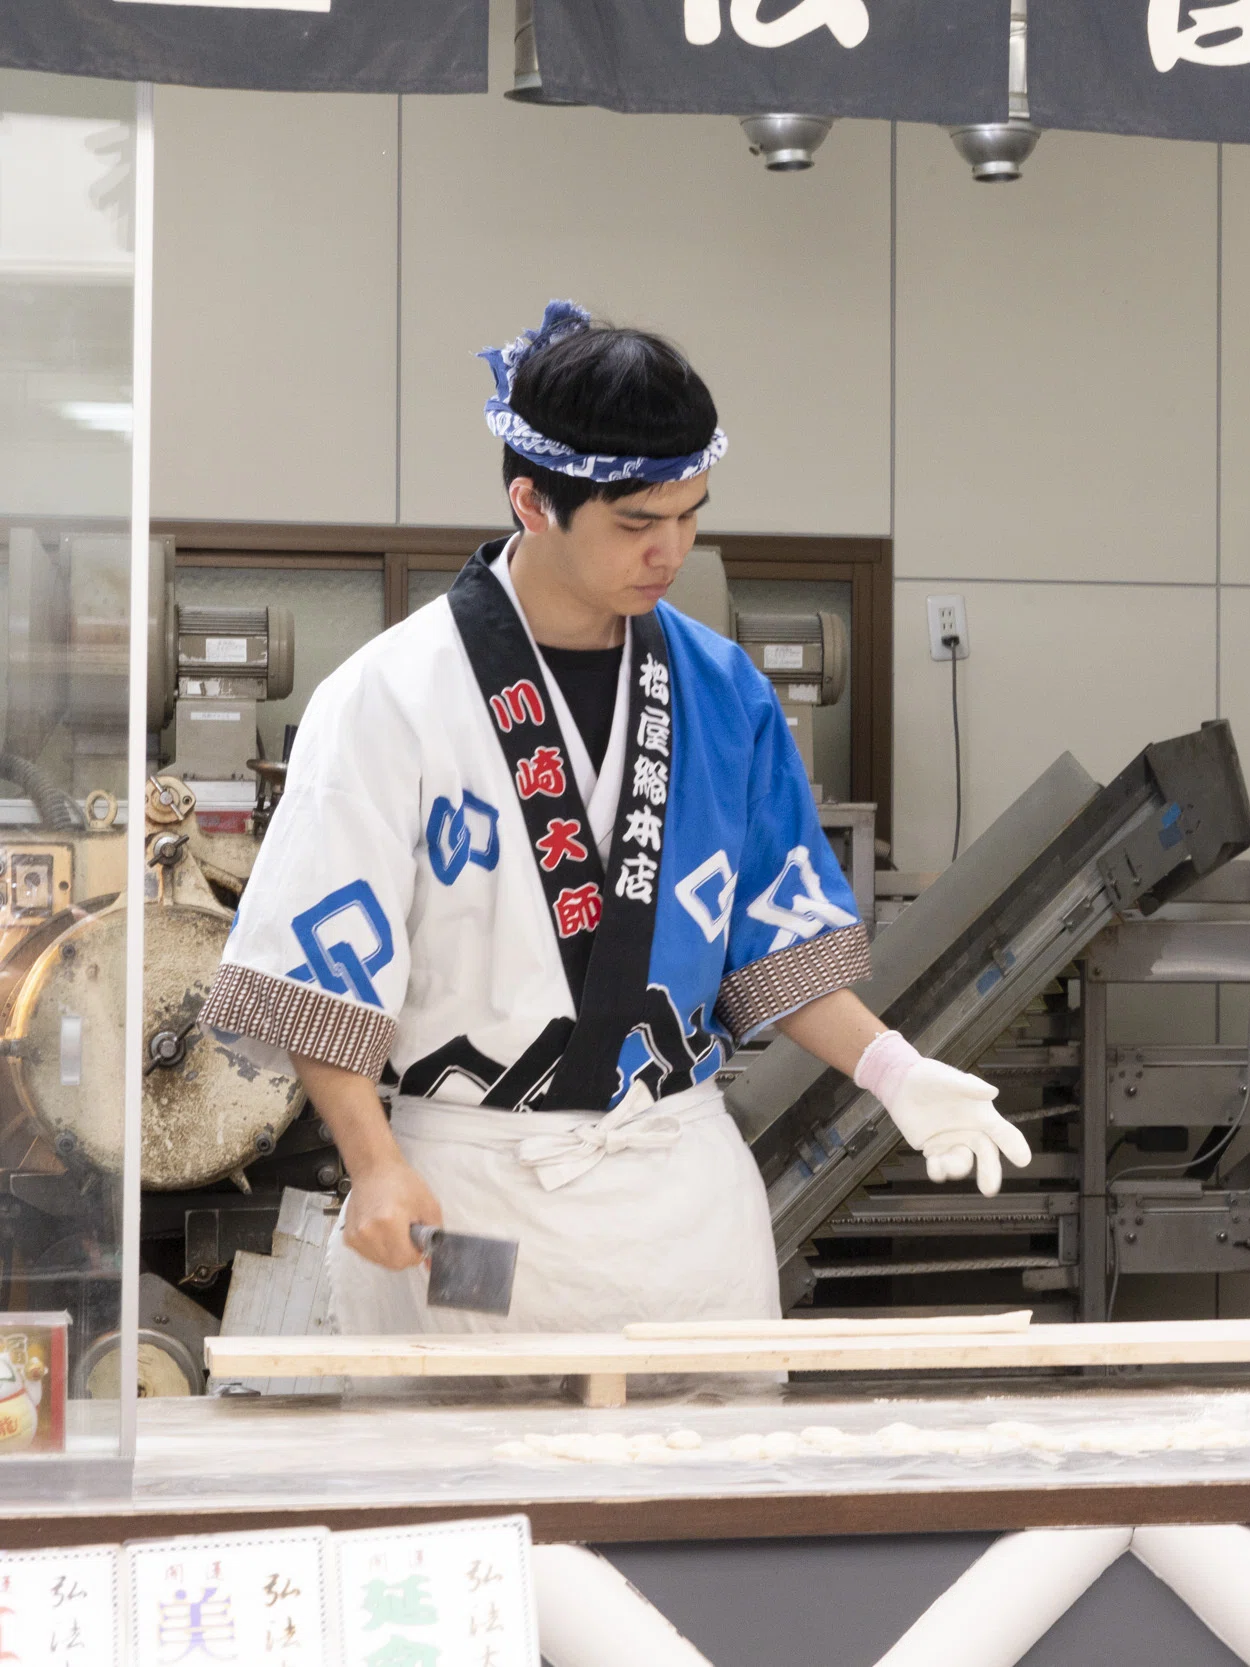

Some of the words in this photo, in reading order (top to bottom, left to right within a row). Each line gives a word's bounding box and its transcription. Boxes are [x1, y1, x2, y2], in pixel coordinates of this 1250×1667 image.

[489, 678, 603, 938] 川崎大師
[49, 1574, 89, 1667] 弘法
[263, 1572, 302, 1667] 弘法
